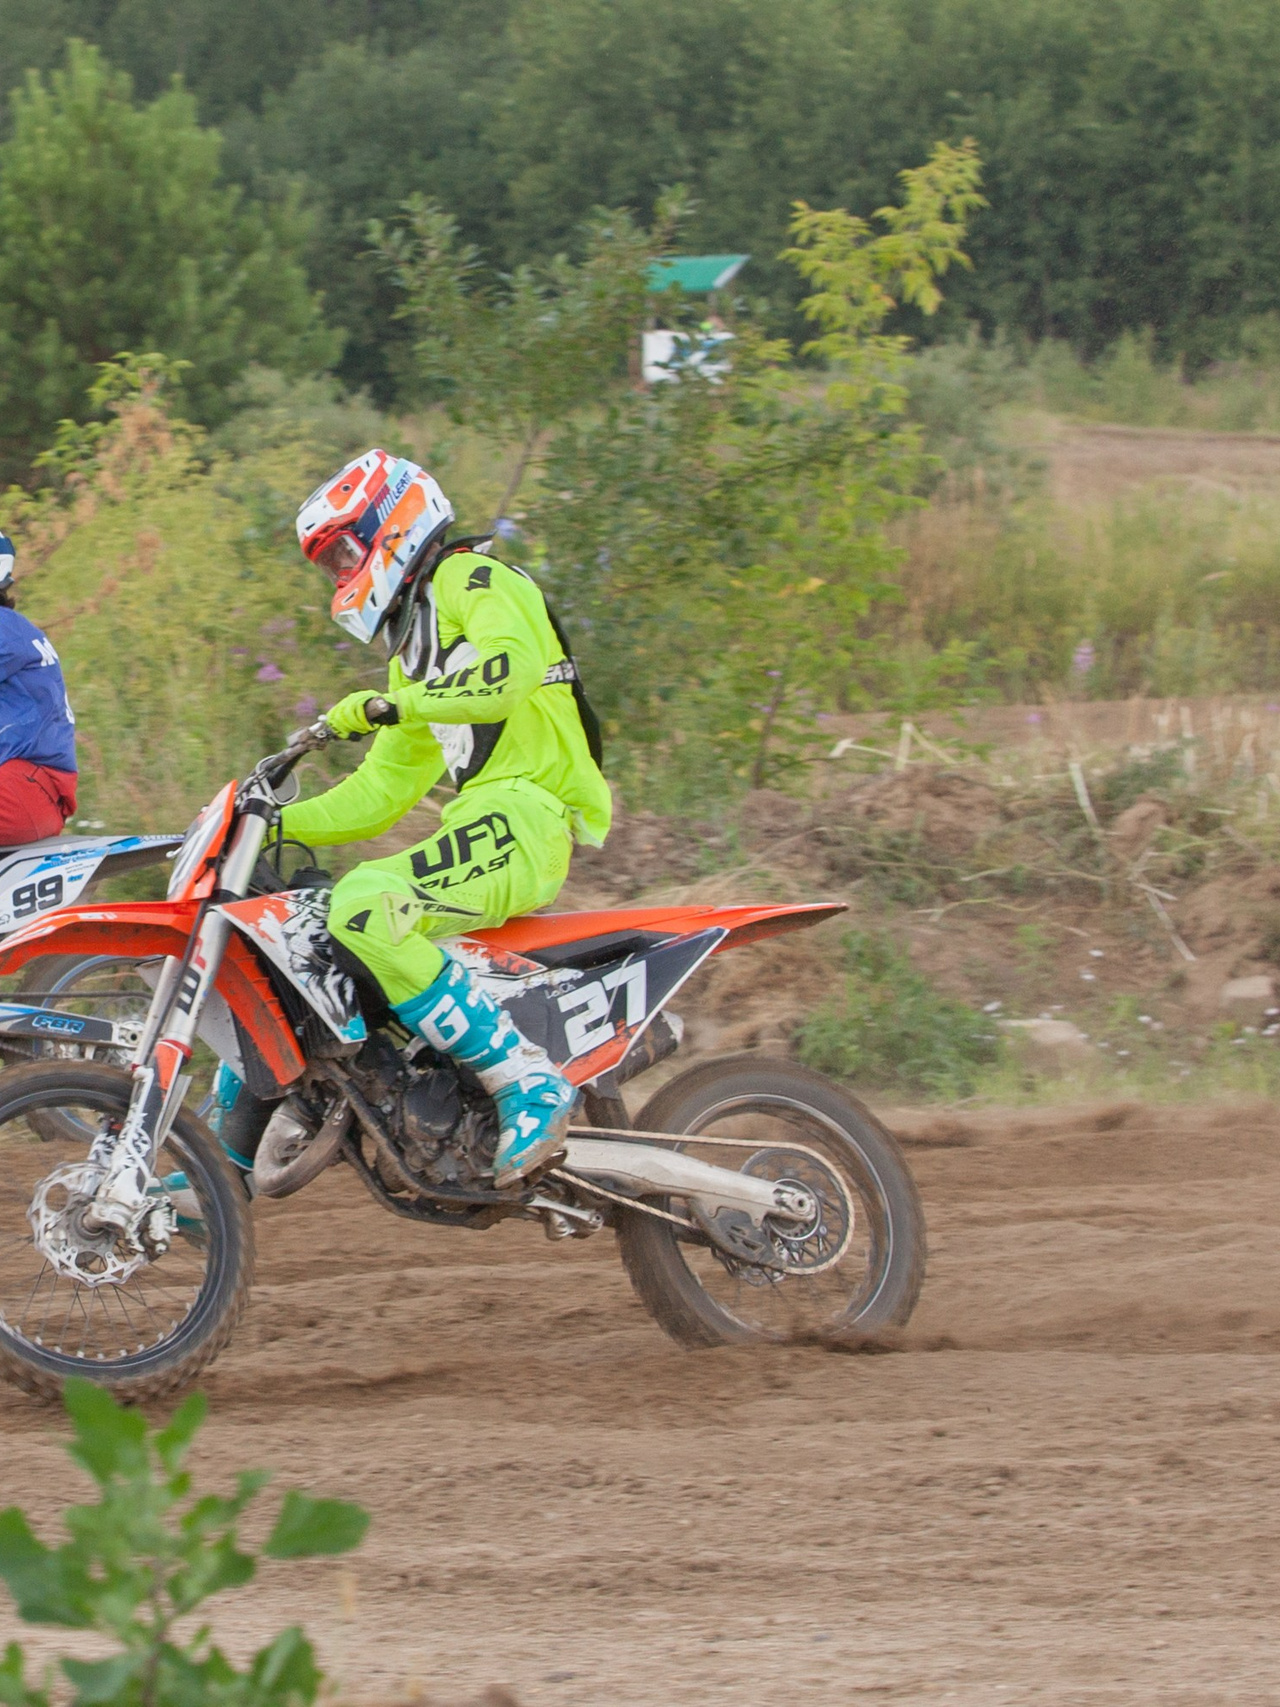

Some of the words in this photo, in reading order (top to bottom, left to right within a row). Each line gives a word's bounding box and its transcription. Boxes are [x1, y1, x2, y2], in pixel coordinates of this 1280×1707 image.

[392, 470, 412, 500] LEATT
[425, 652, 510, 690] UFO
[410, 811, 516, 879] UFO
[419, 847, 516, 889] PLAST
[12, 874, 63, 919] 99
[32, 1015, 85, 1034] FBR
[557, 960, 646, 1057] 27
